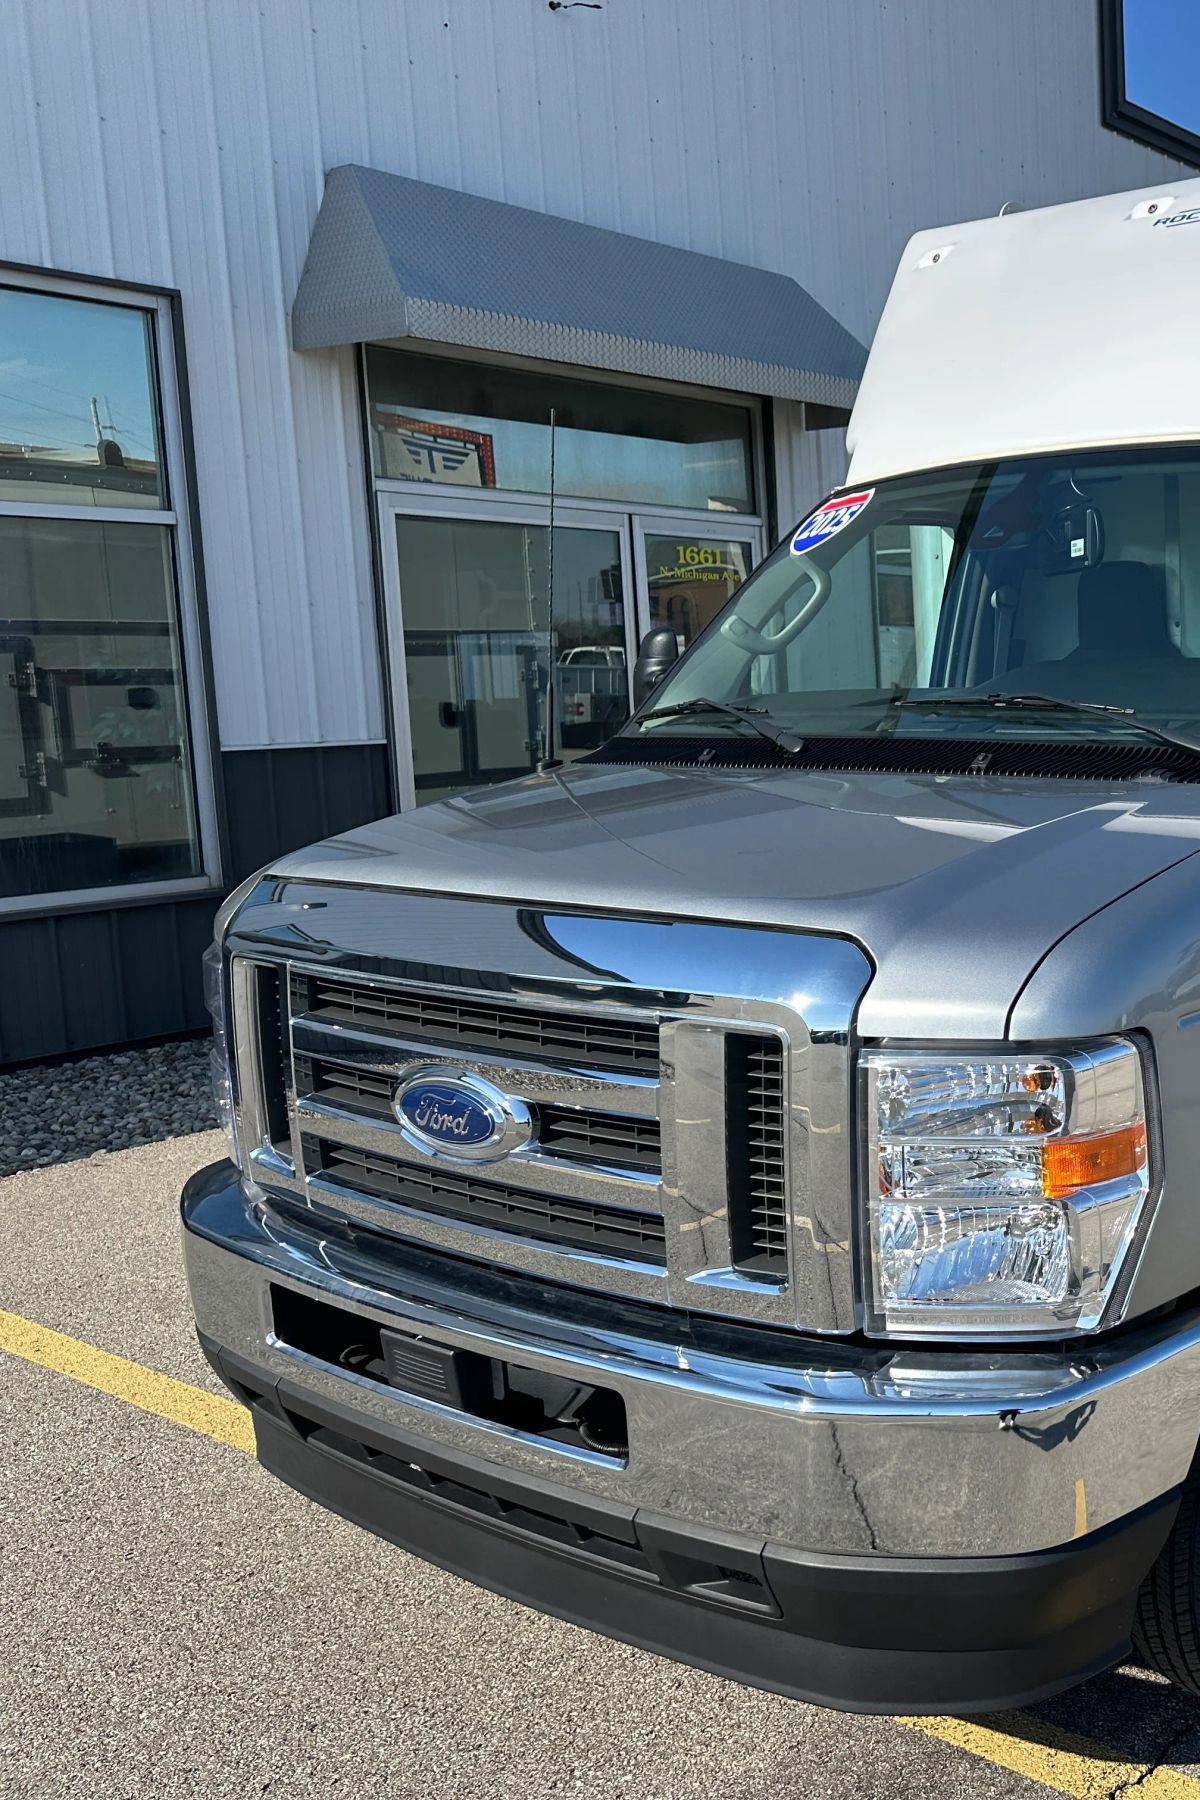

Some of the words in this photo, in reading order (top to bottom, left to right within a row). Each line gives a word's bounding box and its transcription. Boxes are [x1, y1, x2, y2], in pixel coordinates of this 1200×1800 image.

[796, 504, 861, 541] 2025
[676, 545, 721, 566] 1661
[674, 567, 720, 581] Michigan
[414, 1093, 473, 1136] Ford
